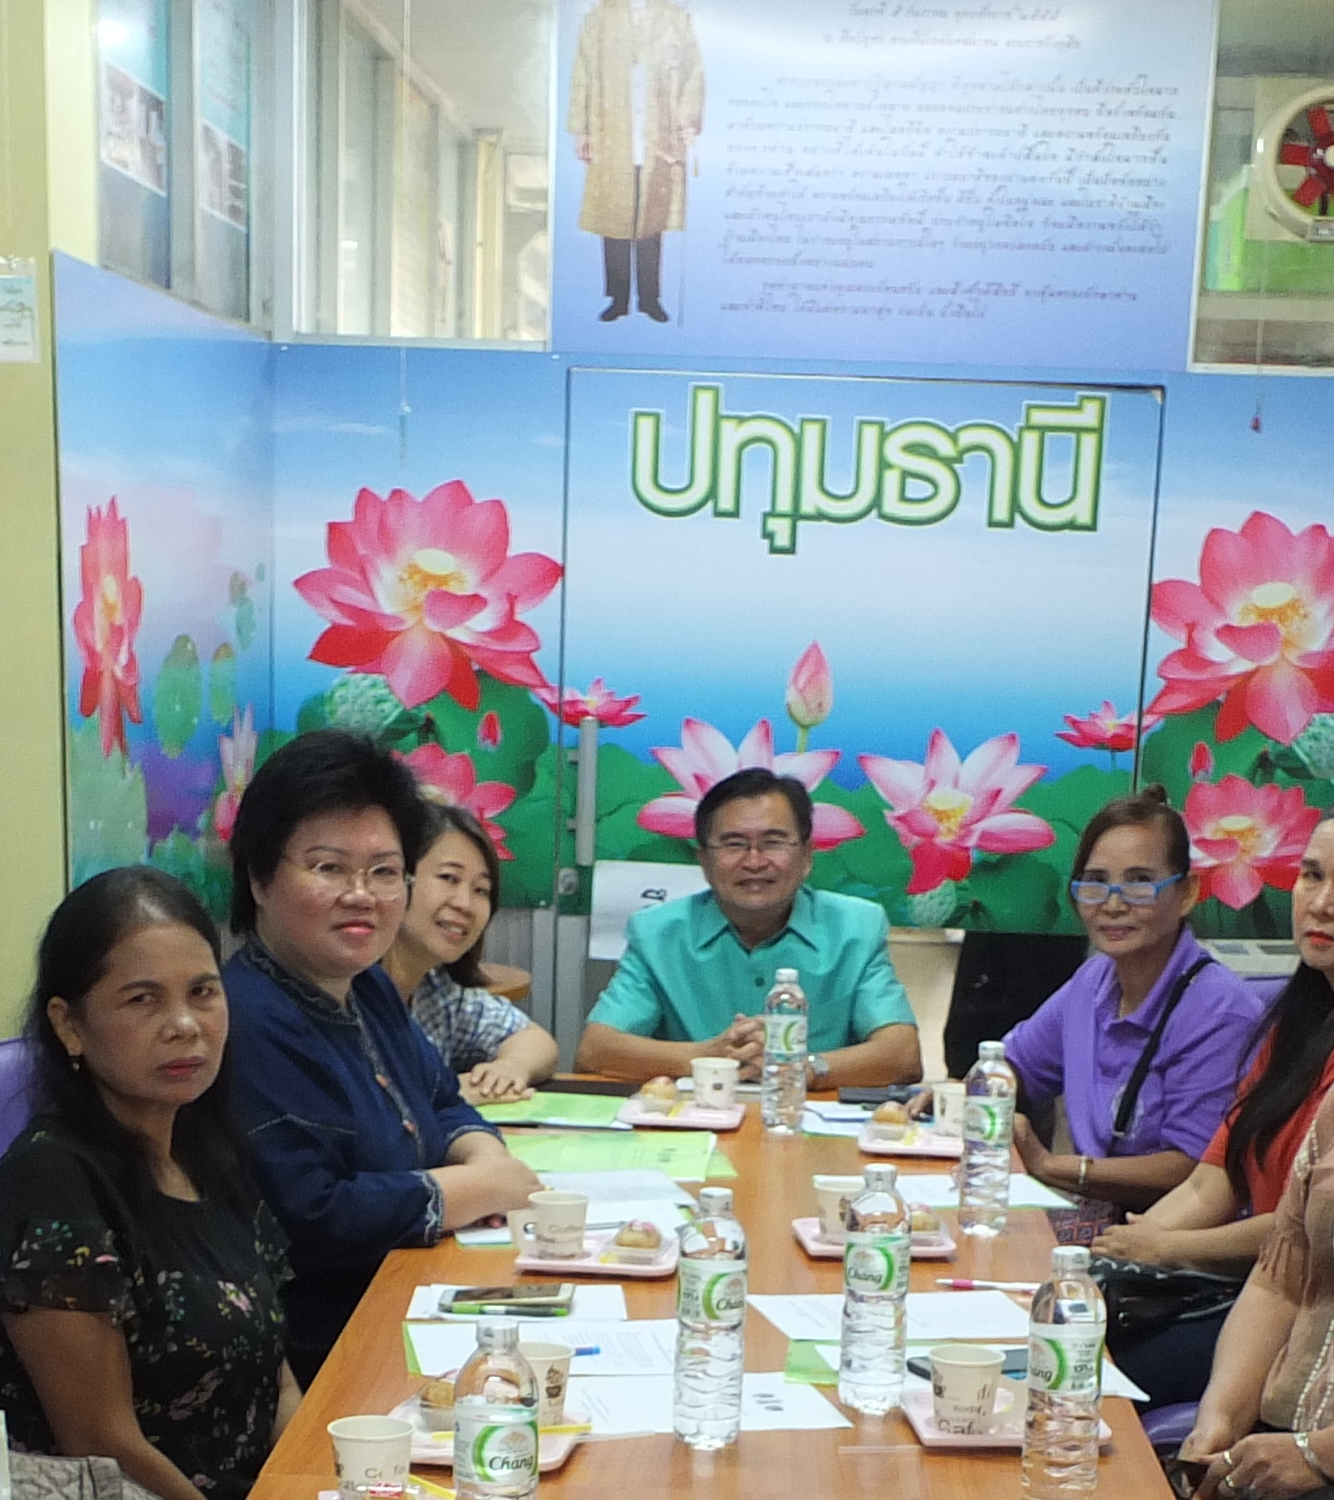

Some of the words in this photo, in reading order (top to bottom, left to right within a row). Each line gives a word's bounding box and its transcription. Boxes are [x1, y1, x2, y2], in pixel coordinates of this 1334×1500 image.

[631, 384, 1110, 554] ปทุมธานี
[848, 1265, 883, 1285] Chang
[716, 1297, 745, 1310] Chan
[489, 1455, 534, 1471] Chang
